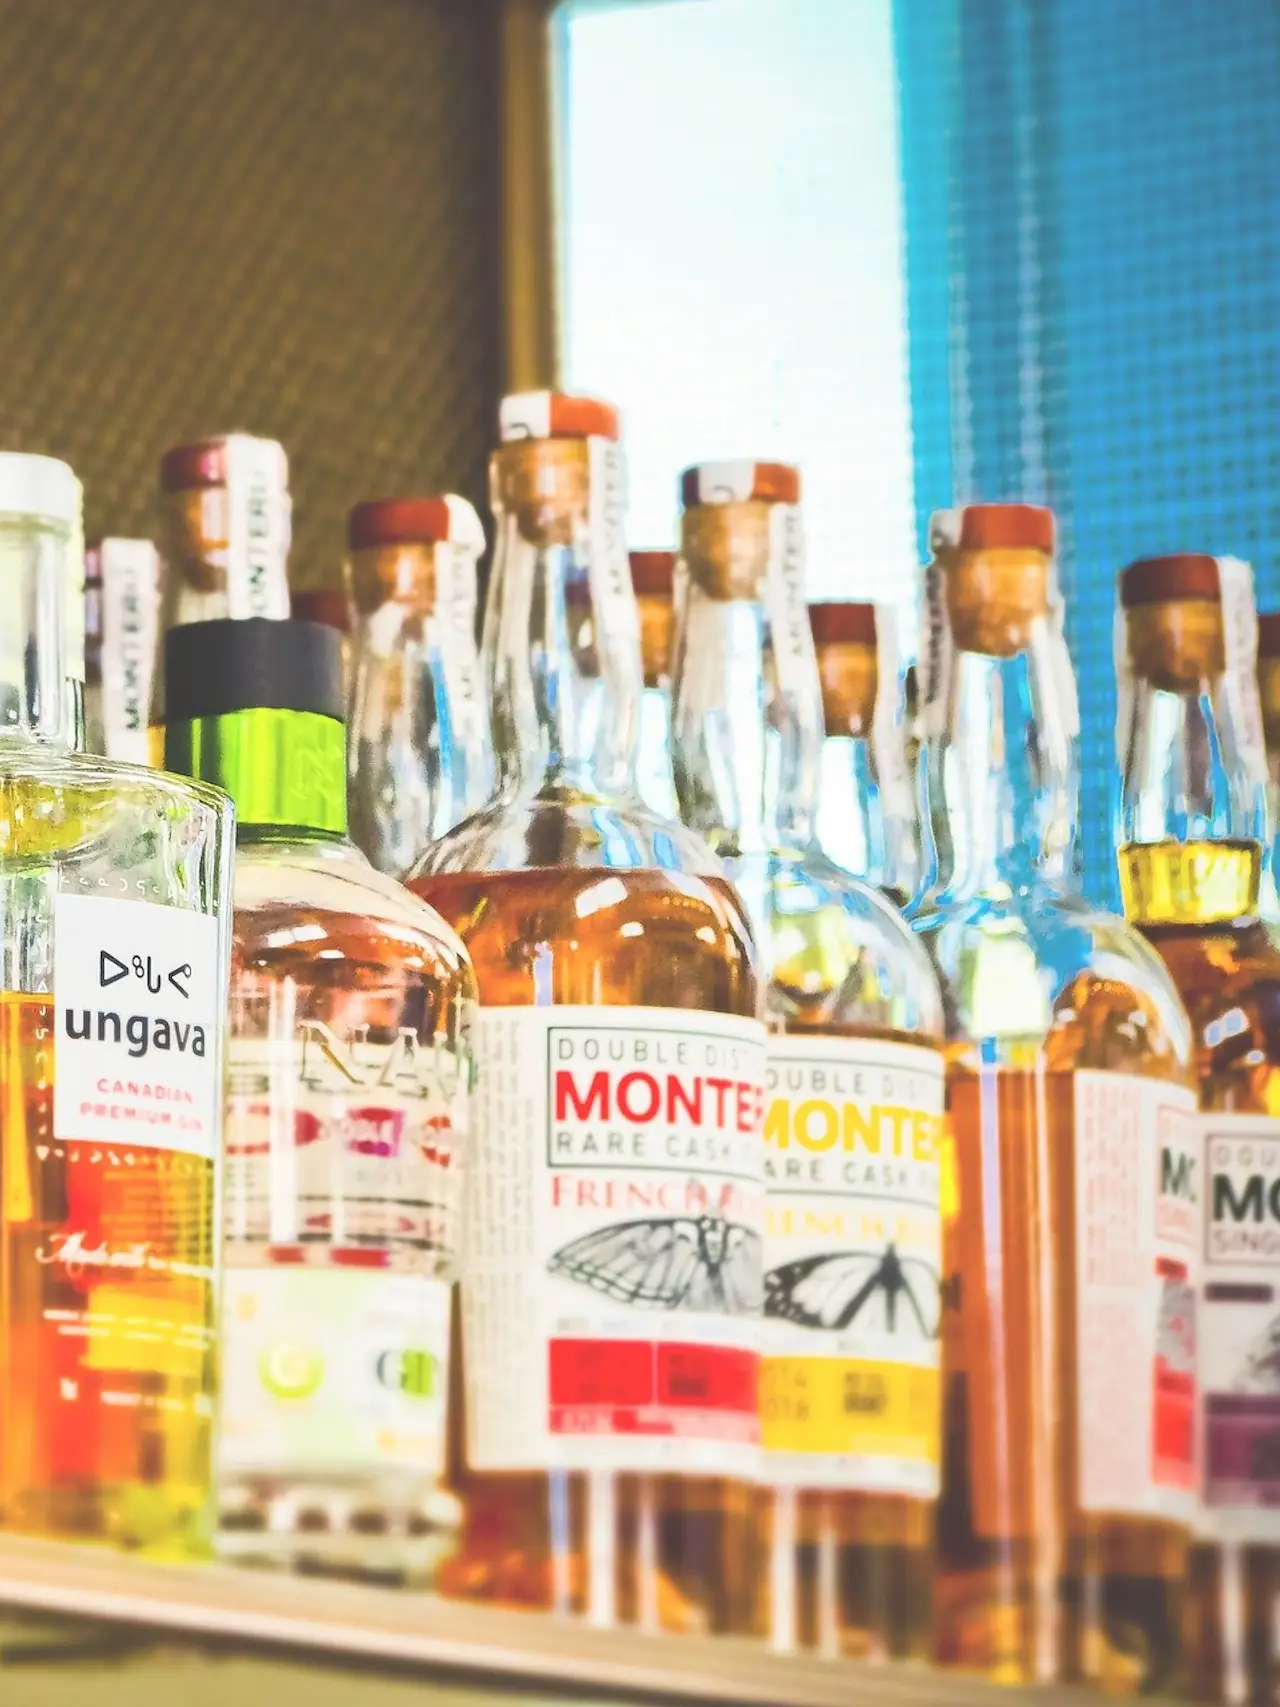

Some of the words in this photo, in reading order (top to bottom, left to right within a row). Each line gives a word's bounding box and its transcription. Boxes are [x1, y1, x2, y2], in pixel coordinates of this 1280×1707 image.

[64, 1008, 207, 1058] ungava
[557, 1038, 687, 1065] DOUBLE
[97, 1077, 195, 1105] CANADIAN
[765, 1068, 866, 1095] OUBLE
[556, 1131, 646, 1157] RARE
